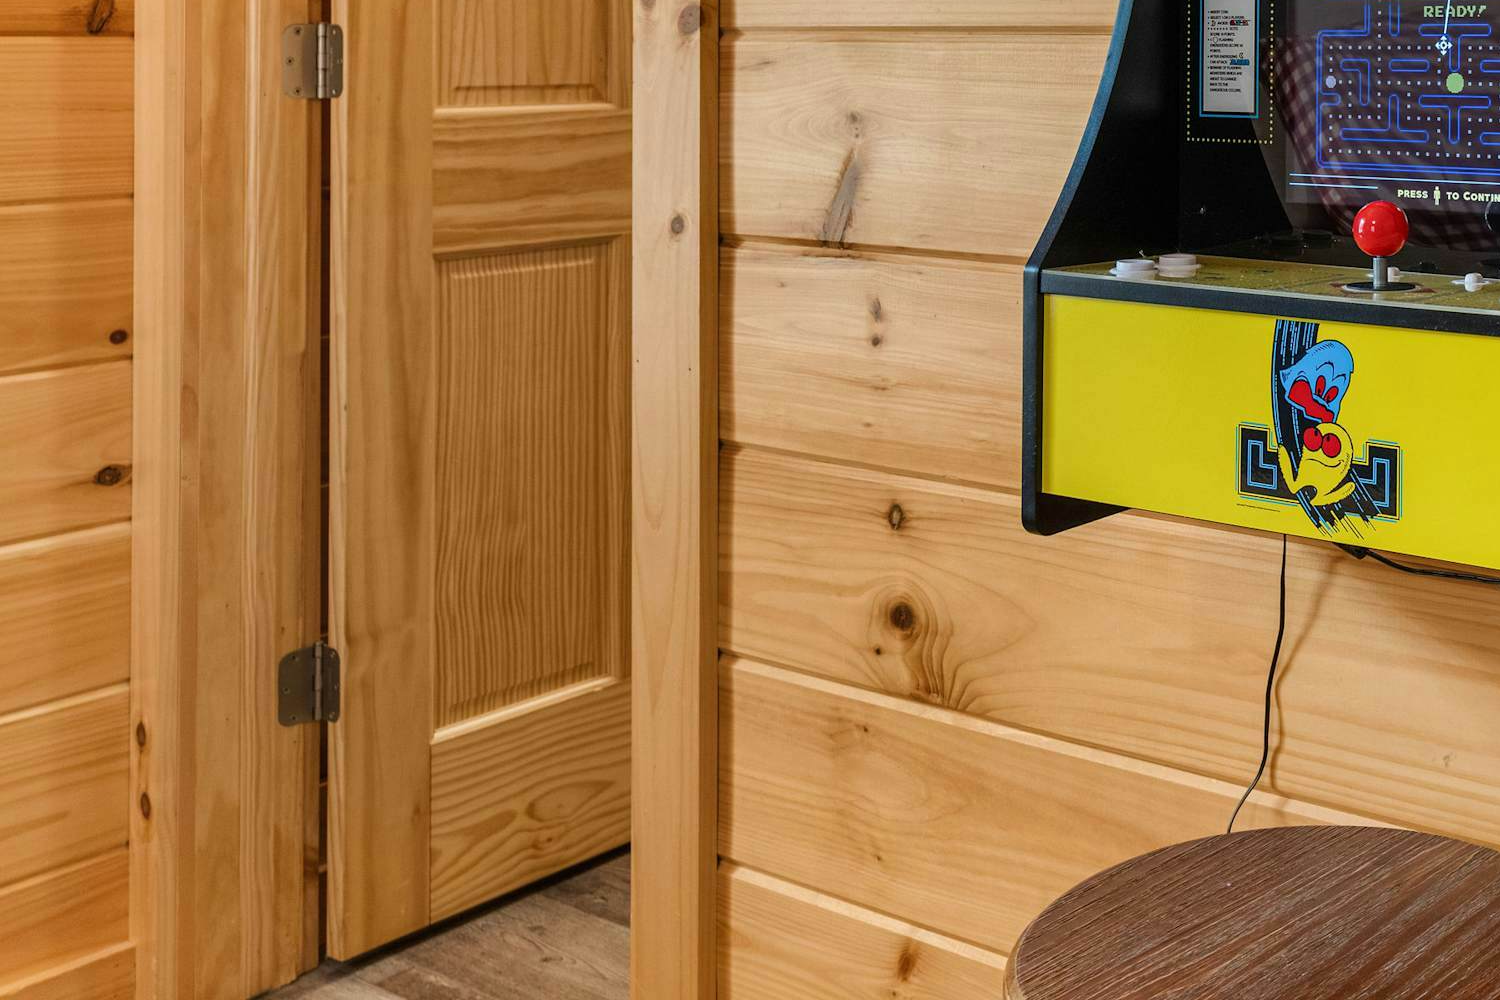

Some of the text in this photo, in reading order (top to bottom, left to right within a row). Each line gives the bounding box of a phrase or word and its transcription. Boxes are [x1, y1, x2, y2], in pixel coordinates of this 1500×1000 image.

[1423, 5, 1487, 18] READY!
[1397, 189, 1428, 199] PRESS
[1446, 191, 1459, 200] TO
